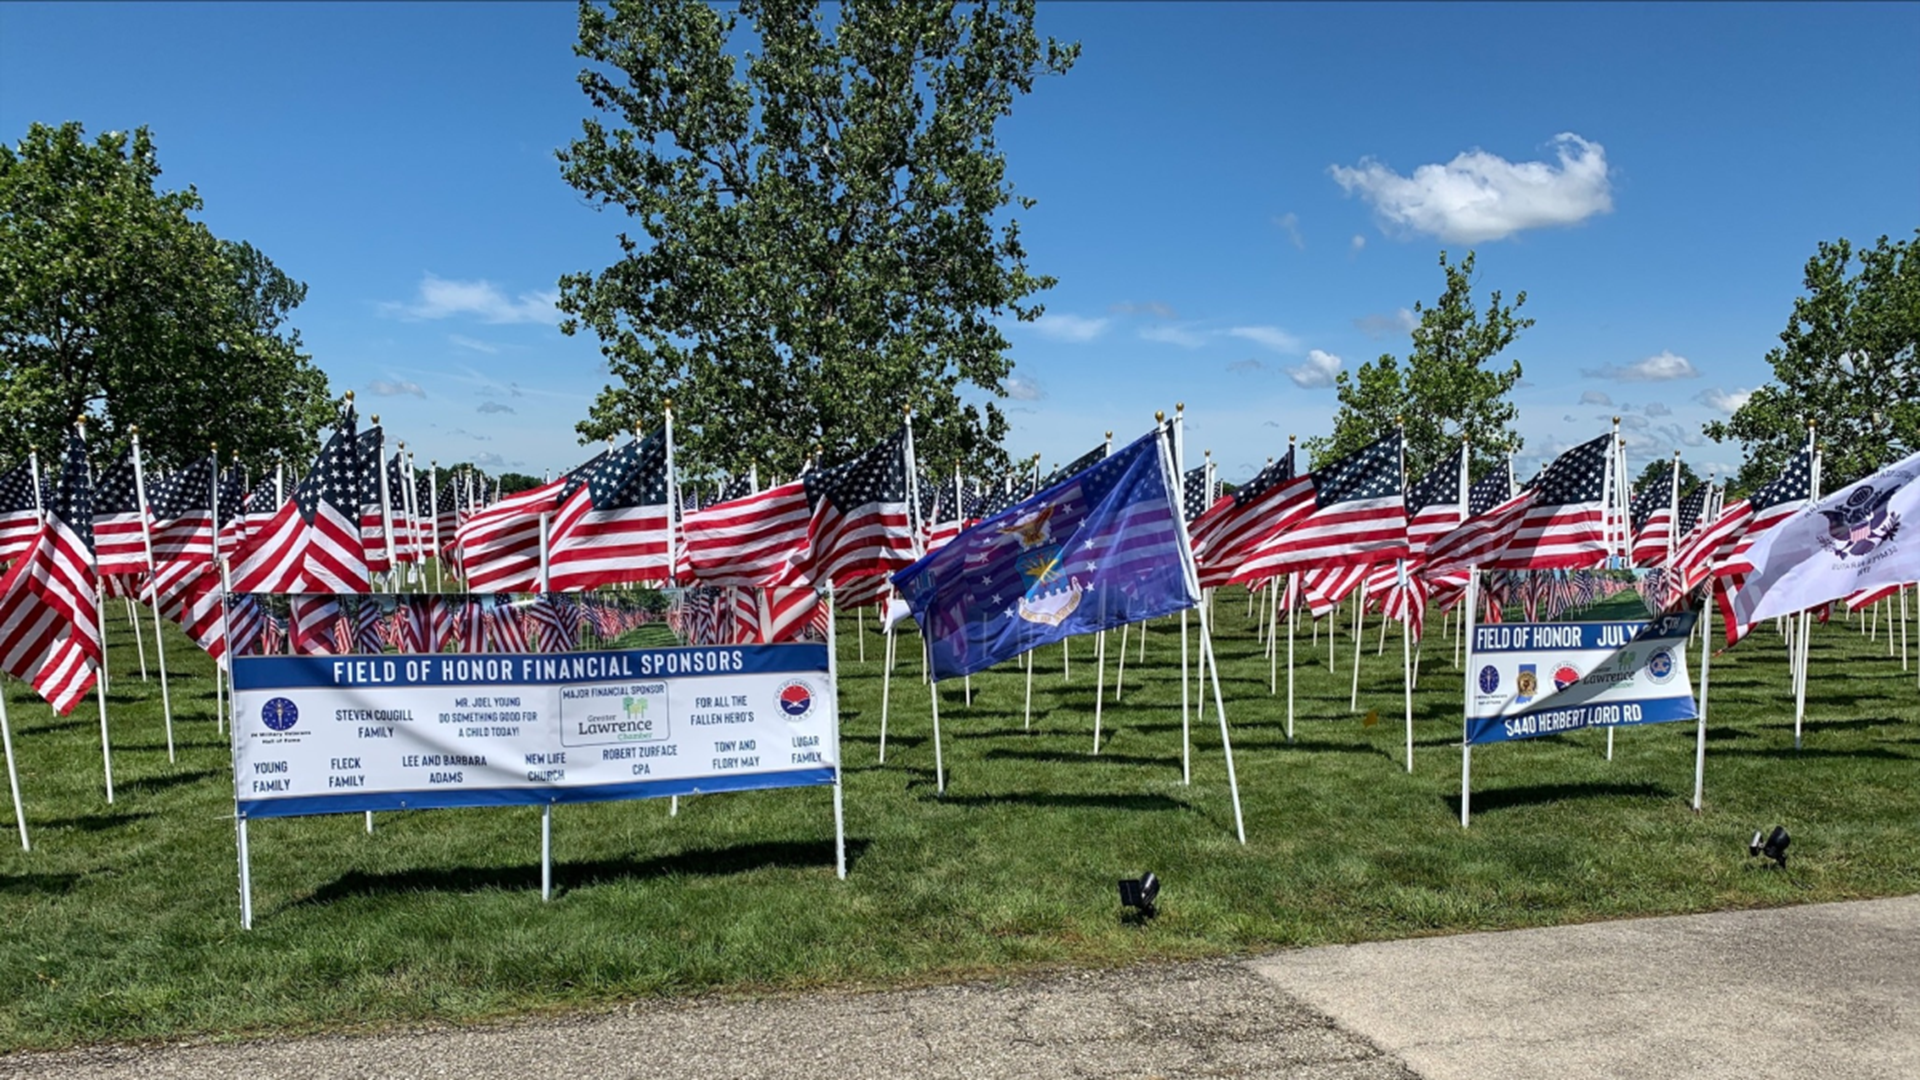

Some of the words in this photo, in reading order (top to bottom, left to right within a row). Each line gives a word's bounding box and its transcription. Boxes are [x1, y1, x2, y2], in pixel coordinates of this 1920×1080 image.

[1477, 627, 1510, 649] FIELD
[1513, 627, 1530, 648] OF
[1533, 625, 1582, 648] HONOR
[1597, 624, 1638, 647] JULY
[333, 661, 397, 683] FIELD
[406, 660, 432, 682] OF
[441, 659, 513, 681] HONOR
[523, 656, 632, 682] FINANCIAL
[641, 650, 743, 675] SPONSORS
[1583, 671, 1635, 685] Lawrence
[563, 689, 590, 700] MAJOR
[591, 686, 629, 698] FINANCIAL
[630, 684, 665, 696] SPONSOR
[455, 698, 470, 708] MR.
[472, 698, 492, 708] JOEL
[494, 697, 521, 707] YOUNG
[695, 697, 713, 709] FOR
[714, 696, 729, 708] ALL
[730, 695, 748, 707] THE
[335, 709, 373, 722] STEVEN
[374, 709, 414, 722] COUGILL
[439, 712, 450, 724] DO
[451, 712, 498, 723] SOMETHING
[499, 711, 521, 723] GOOD
[522, 711, 537, 722] FOR
[587, 714, 617, 723] Greater
[690, 713, 723, 726] FALLEN
[724, 711, 755, 723] HERO'S
[1538, 708, 1586, 732] HERBERT
[1587, 704, 1620, 724] LORD
[1623, 703, 1643, 723] RD
[358, 726, 394, 739] FAMILY
[458, 728, 465, 738] A
[466, 727, 490, 738] CHILD
[490, 726, 520, 737] TODAY!
[578, 719, 652, 735] Lawrence
[617, 732, 653, 741] Chamber
[791, 735, 820, 748] LUGAR
[603, 747, 637, 760] ROBERT
[638, 744, 678, 758] ZURFACE
[714, 740, 737, 752] TONY
[737, 739, 756, 751] AND
[331, 757, 361, 770] FLECK
[402, 755, 420, 768] LEE
[421, 755, 442, 767] AND
[443, 754, 487, 767] BARBARA
[525, 753, 546, 765] NEW
[547, 752, 566, 764] LIFE
[712, 757, 740, 770] FLORY
[741, 756, 760, 768] MAY
[791, 751, 822, 764] FAMILY
[253, 761, 289, 774] YOUNG
[632, 763, 651, 775] CPA
[329, 775, 365, 788] FAMILY
[429, 771, 464, 784] ADAMS
[528, 769, 565, 782] CHURCH
[253, 779, 291, 793] FAMILY
